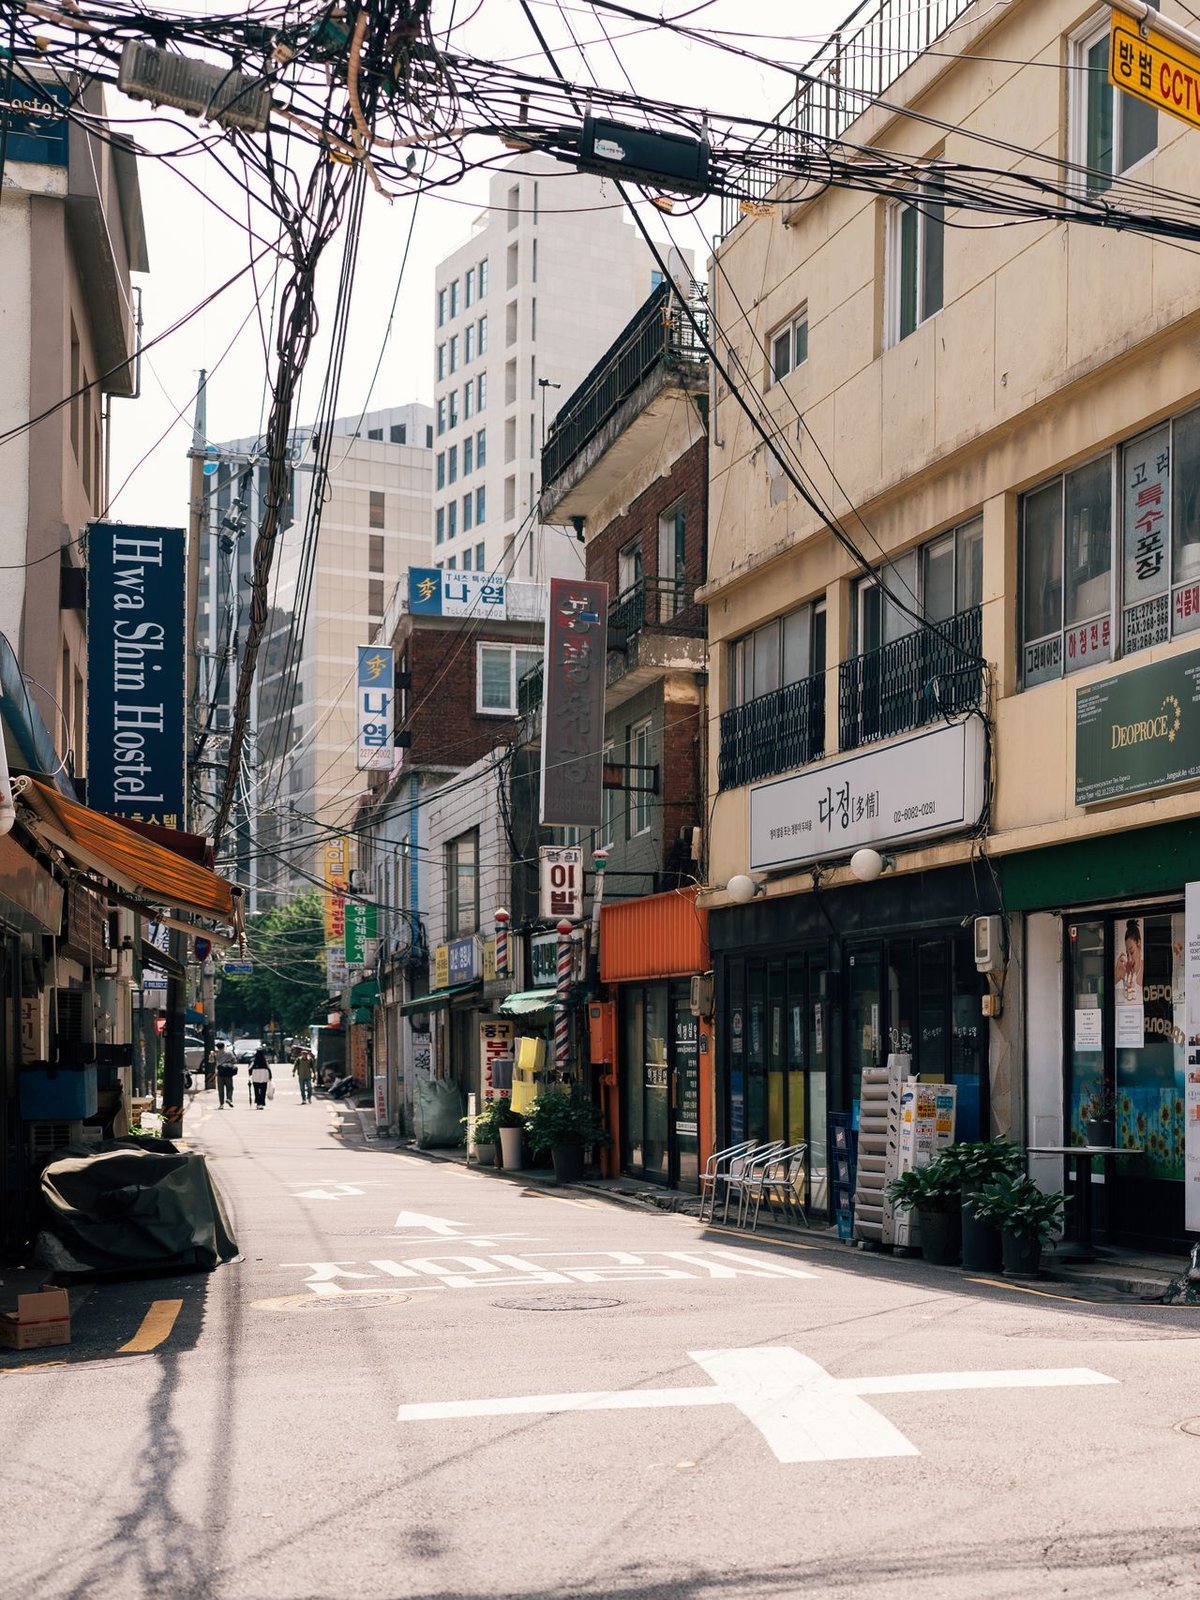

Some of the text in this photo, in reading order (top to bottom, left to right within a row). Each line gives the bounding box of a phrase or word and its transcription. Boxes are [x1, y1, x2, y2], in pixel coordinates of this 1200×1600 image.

[1119, 40, 1153, 91] 방범
[1134, 483, 1164, 580] 특수포장
[445, 583, 504, 605] 나염
[1127, 597, 1169, 623] TEL:278-966
[1068, 620, 1110, 658] 하청전문
[1126, 627, 1169, 653] 공장:268-332
[1127, 611, 1169, 638] FAX:268-966
[112, 534, 165, 803] Hwa Shin Hostel
[1027, 638, 1062, 673] 그라비아인
[363, 693, 391, 747] 나염
[1111, 715, 1168, 750] DEOPROCE
[818, 781, 850, 833] 다정
[550, 864, 578, 915] 이발
[1144, 985, 1172, 1002] ОБРО
[484, 1024, 510, 1038] 중구
